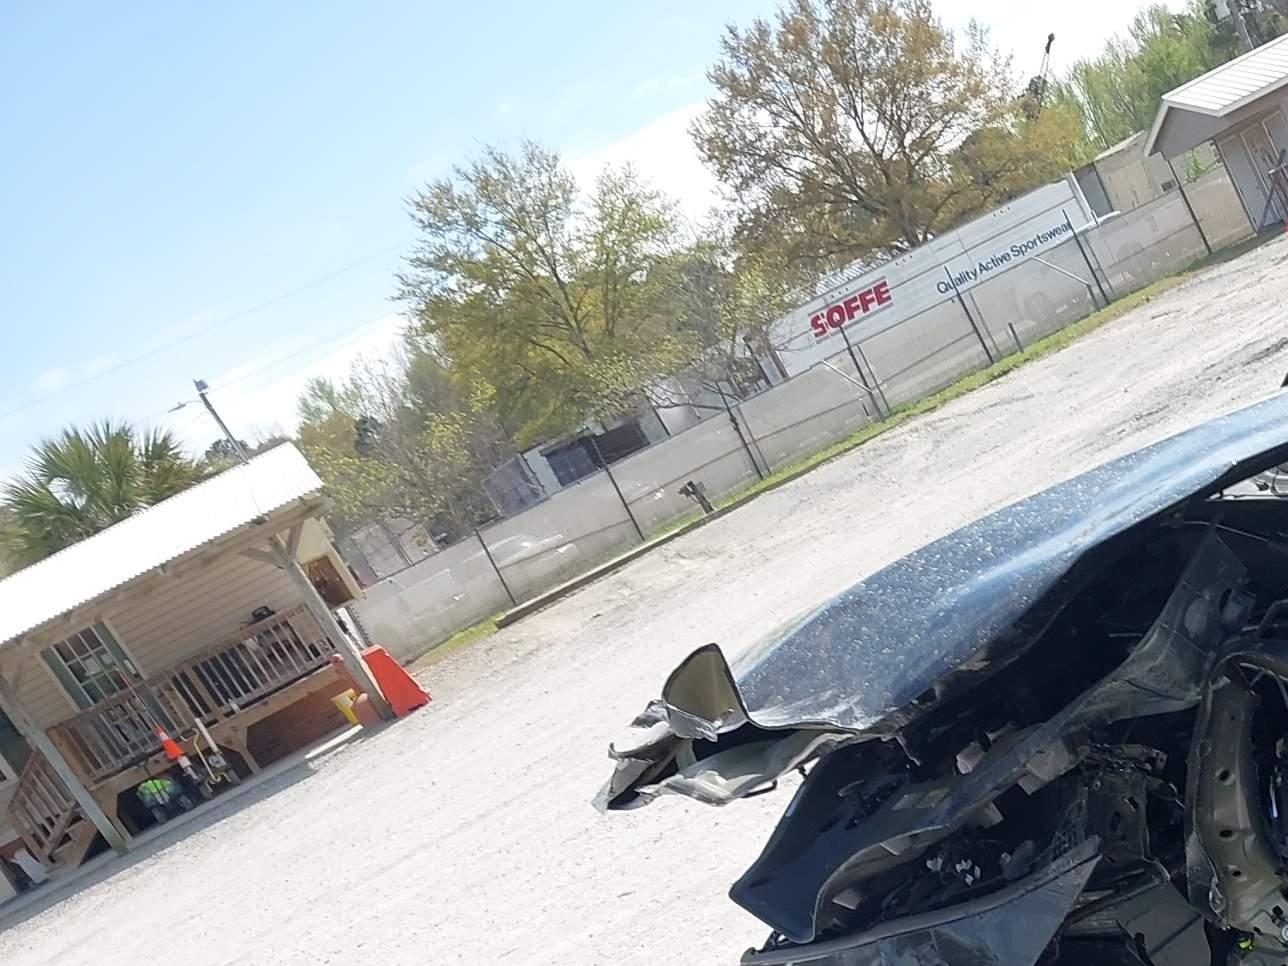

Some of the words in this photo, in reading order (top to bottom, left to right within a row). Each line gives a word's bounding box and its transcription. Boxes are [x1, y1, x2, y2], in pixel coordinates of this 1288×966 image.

[936, 268, 978, 294] Quality
[978, 252, 1012, 275] Active
[1010, 221, 1073, 257] Sportswear
[810, 279, 892, 338] SOFFE
